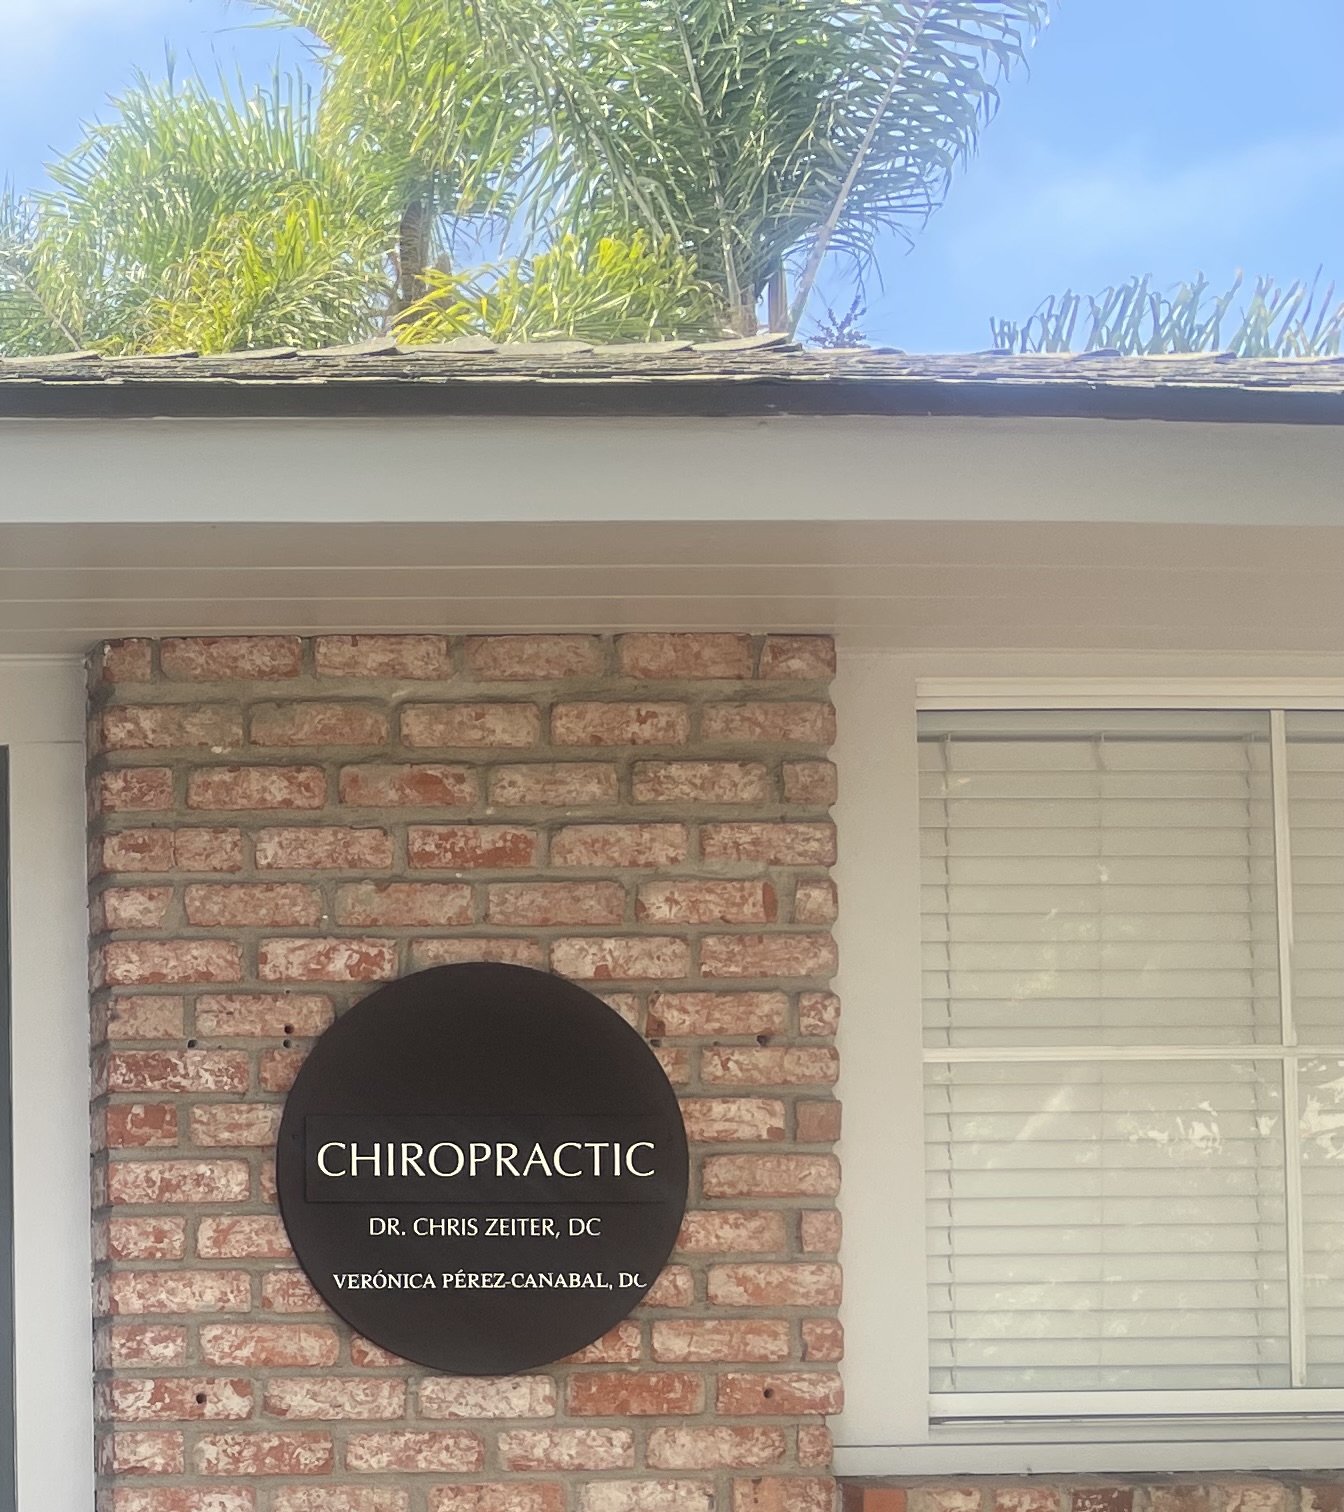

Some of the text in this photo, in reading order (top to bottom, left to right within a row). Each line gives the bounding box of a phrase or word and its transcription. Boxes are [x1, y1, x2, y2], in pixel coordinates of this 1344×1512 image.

[316, 1141, 656, 1178] CHIROPRACTIC
[368, 1217, 602, 1239] DR. CHRIS ZEITER, DC
[332, 1269, 437, 1289] VERÓNICA
[442, 1269, 613, 1290] PÉREZ-CANABAL,
